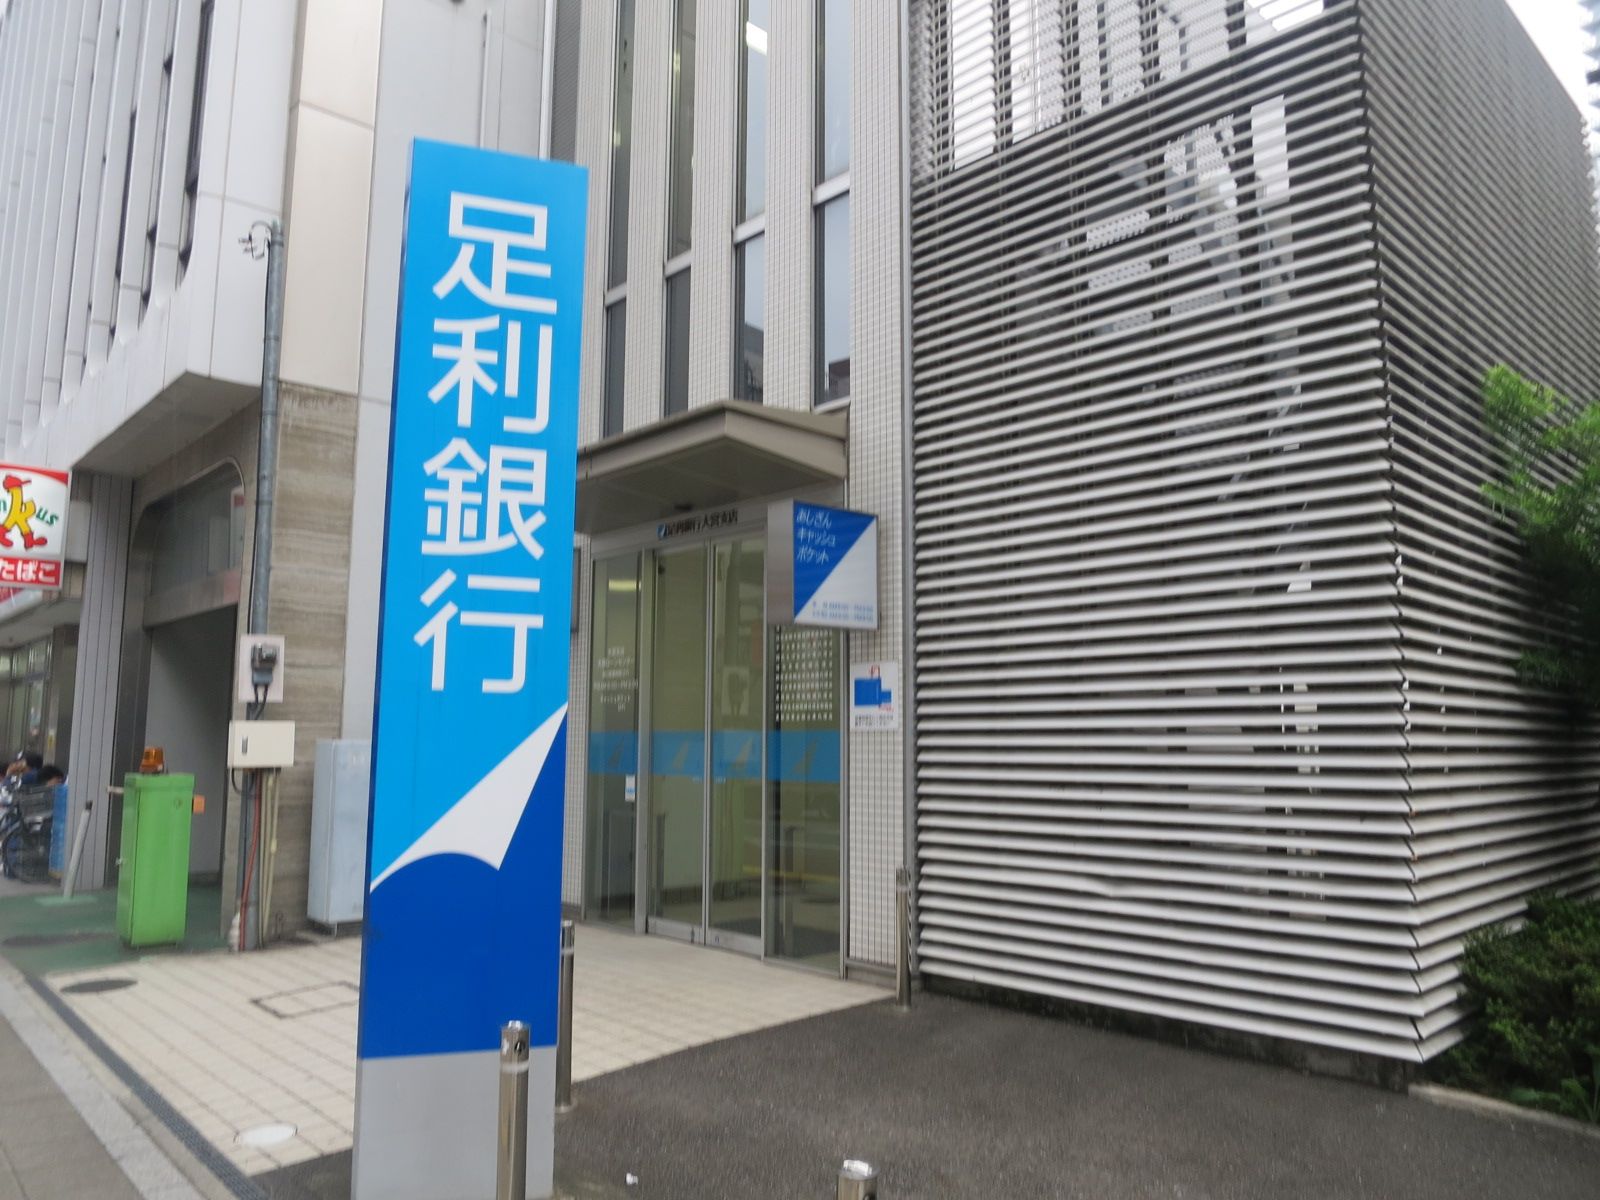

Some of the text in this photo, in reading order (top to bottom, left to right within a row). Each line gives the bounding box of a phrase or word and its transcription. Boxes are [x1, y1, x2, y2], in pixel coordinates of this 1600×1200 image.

[0, 557, 56, 584] たばこ
[413, 190, 558, 694] 足利銀行
